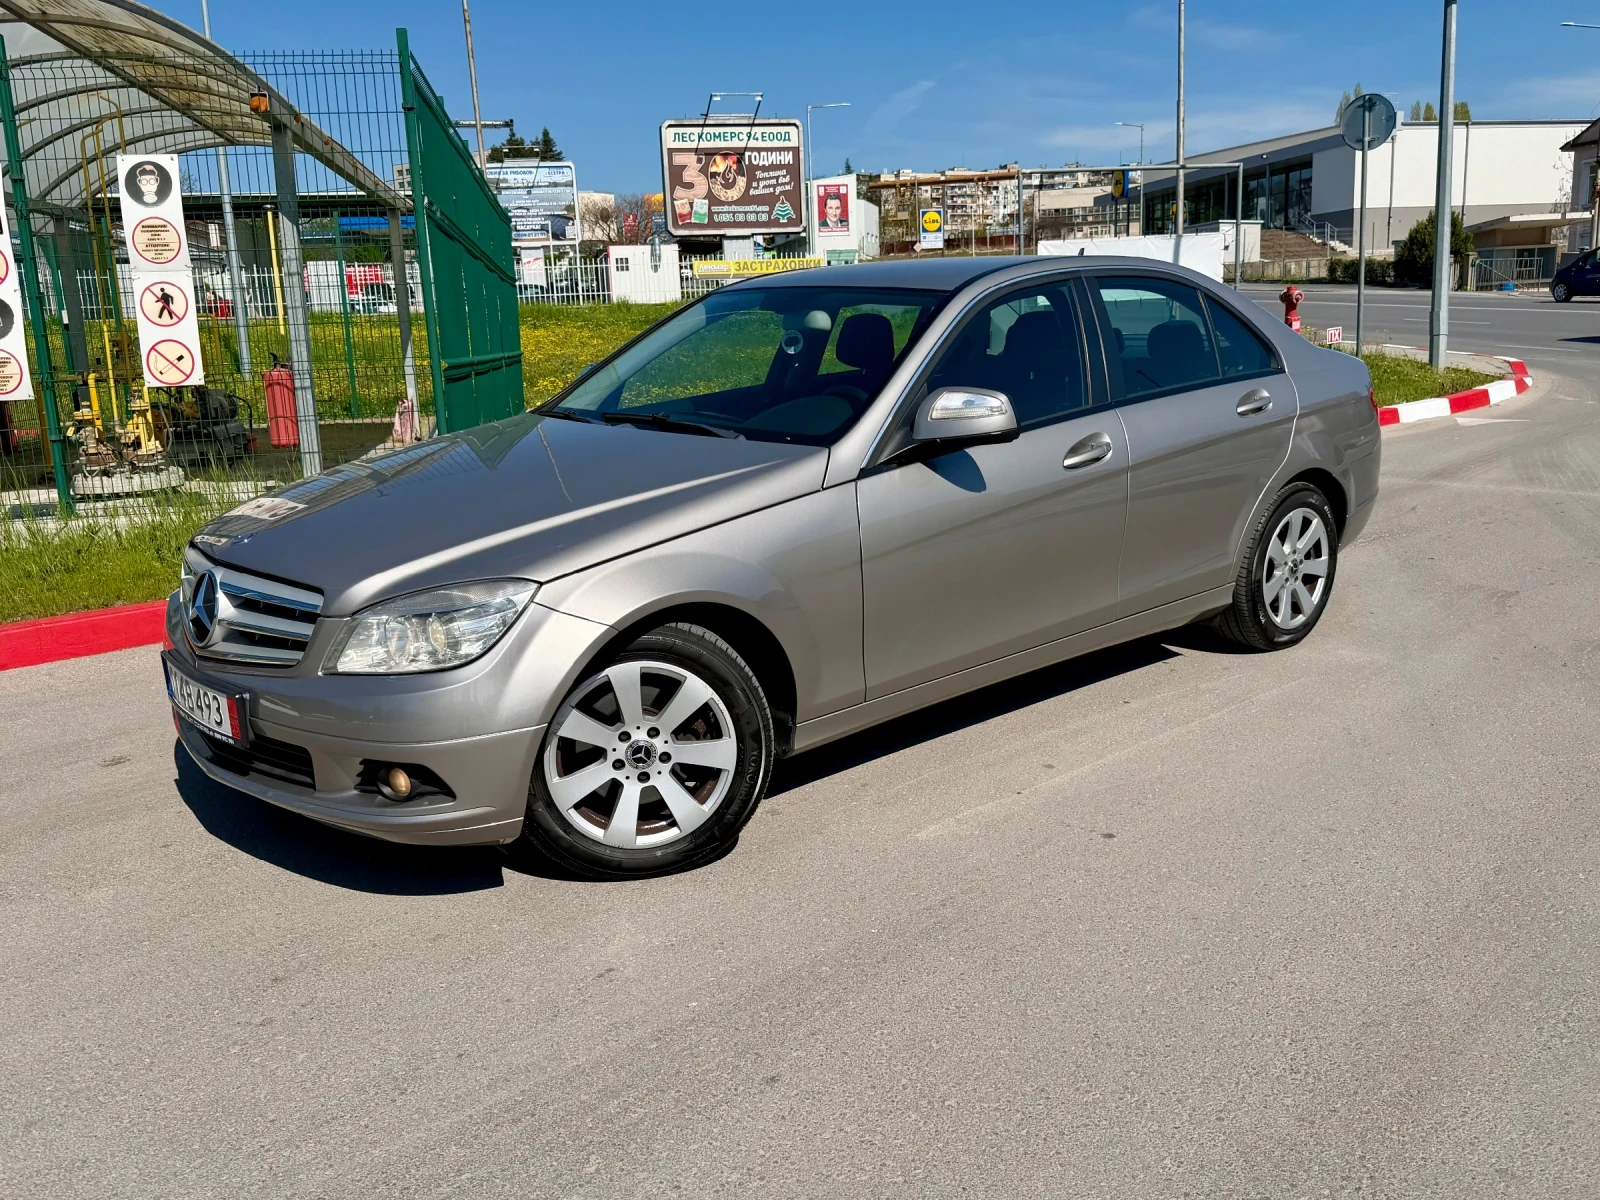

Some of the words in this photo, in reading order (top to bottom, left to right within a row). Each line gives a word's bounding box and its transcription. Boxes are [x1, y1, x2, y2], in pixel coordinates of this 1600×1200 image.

[672, 132, 696, 143] ЛЕС
[697, 131, 745, 143] КОМЕРС
[746, 131, 760, 142] 94
[762, 131, 791, 142] ЕООД
[744, 150, 793, 167] ГОДИНИ
[755, 169, 787, 180] Топлина
[749, 187, 774, 196] вашия
[774, 182, 795, 196] дом!
[758, 180, 777, 190] уют
[778, 176, 791, 184] във
[719, 212, 734, 222] 054
[734, 212, 745, 222] 83
[746, 212, 757, 222] 03
[758, 212, 769, 222] 83
[734, 258, 821, 273] ЗАСТРАХОВКИ
[1328, 328, 1340, 342] ПХ
[195, 687, 224, 728] 493
